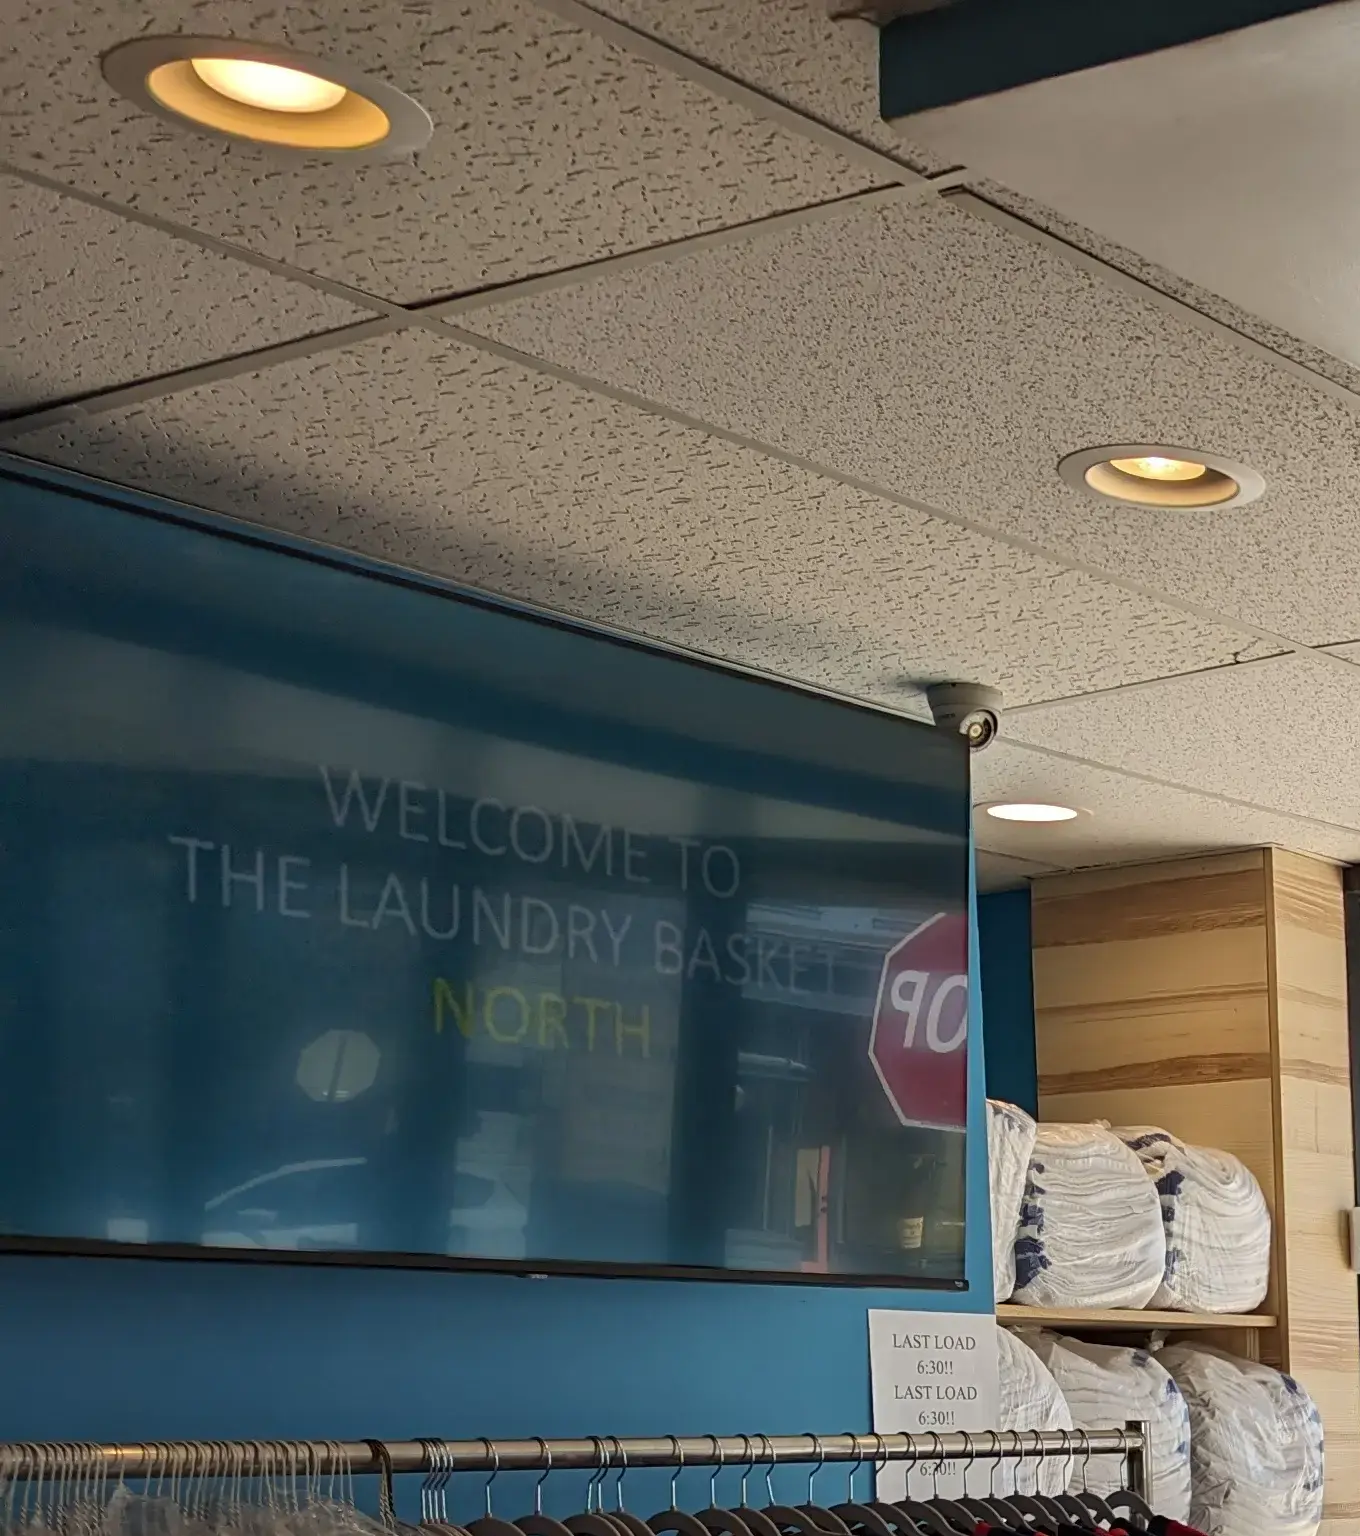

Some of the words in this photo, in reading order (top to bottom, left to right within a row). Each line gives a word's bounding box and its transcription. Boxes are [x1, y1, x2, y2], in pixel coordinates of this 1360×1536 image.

[320, 764, 650, 884] WELCOME
[669, 835, 740, 899] TO
[168, 833, 311, 919] THE
[340, 863, 634, 967] LAUNDRY
[654, 919, 840, 996] BASKET
[433, 977, 651, 1059] NORTH
[892, 1333, 930, 1349] LAST
[934, 1335, 976, 1350] LOAD
[917, 1360, 954, 1375] 6:30!!
[894, 1385, 932, 1400] LAST
[936, 1386, 978, 1401] LOAD
[918, 1411, 955, 1425] 6:30!!
